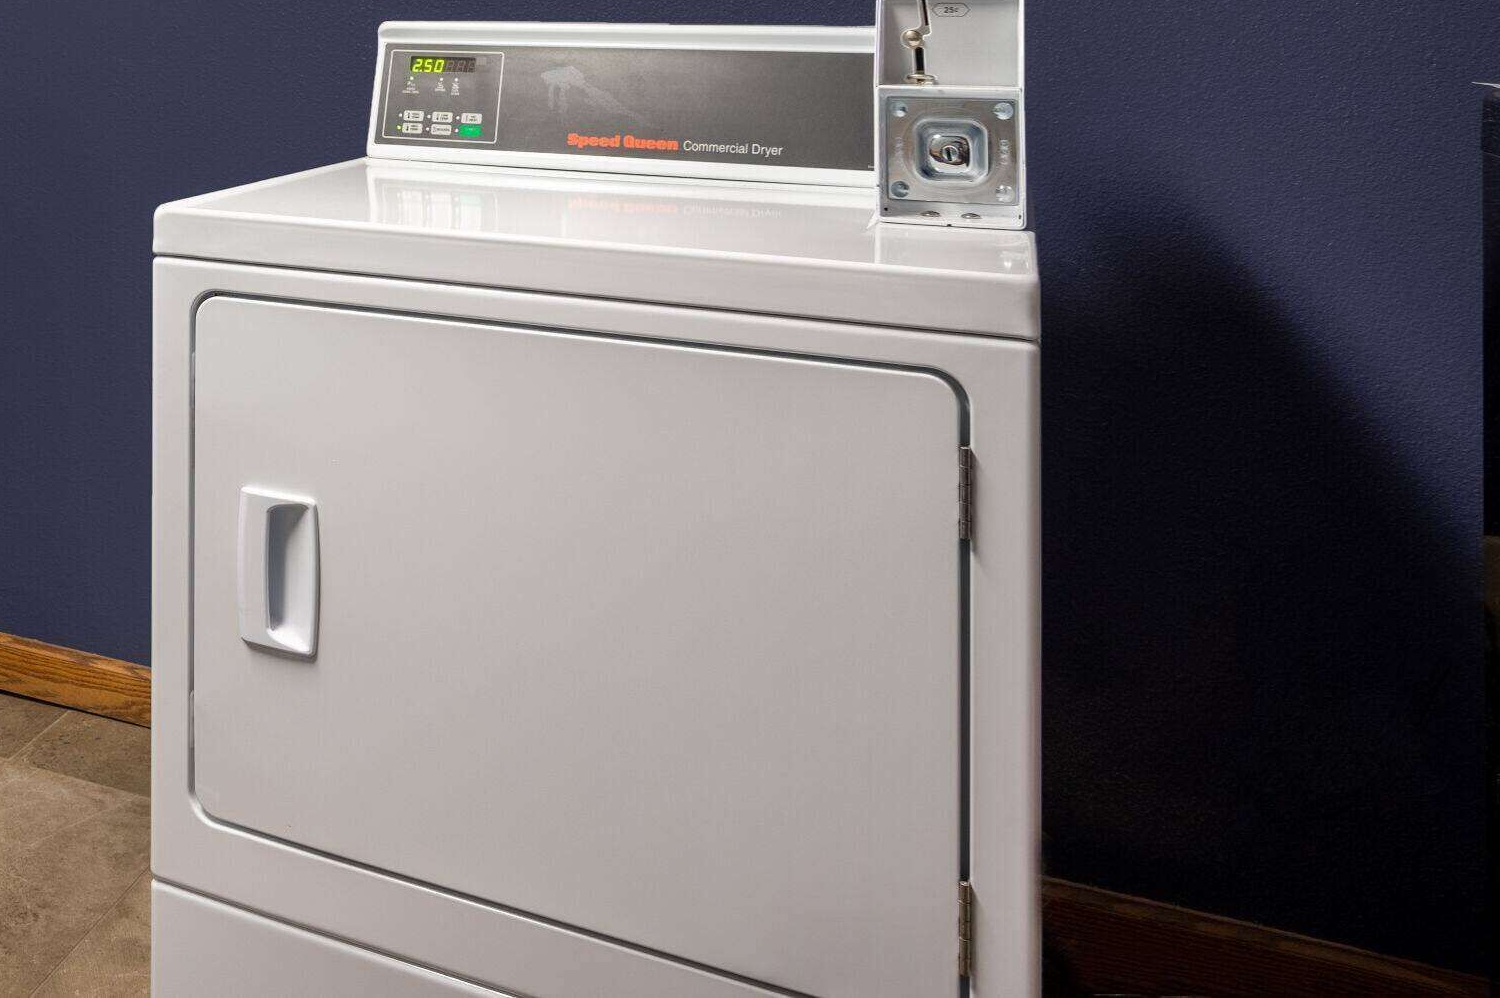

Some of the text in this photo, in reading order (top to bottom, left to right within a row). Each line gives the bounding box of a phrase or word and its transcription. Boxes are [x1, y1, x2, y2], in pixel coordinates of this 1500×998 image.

[567, 133, 783, 158] Speed Queen Commercial Dryer
